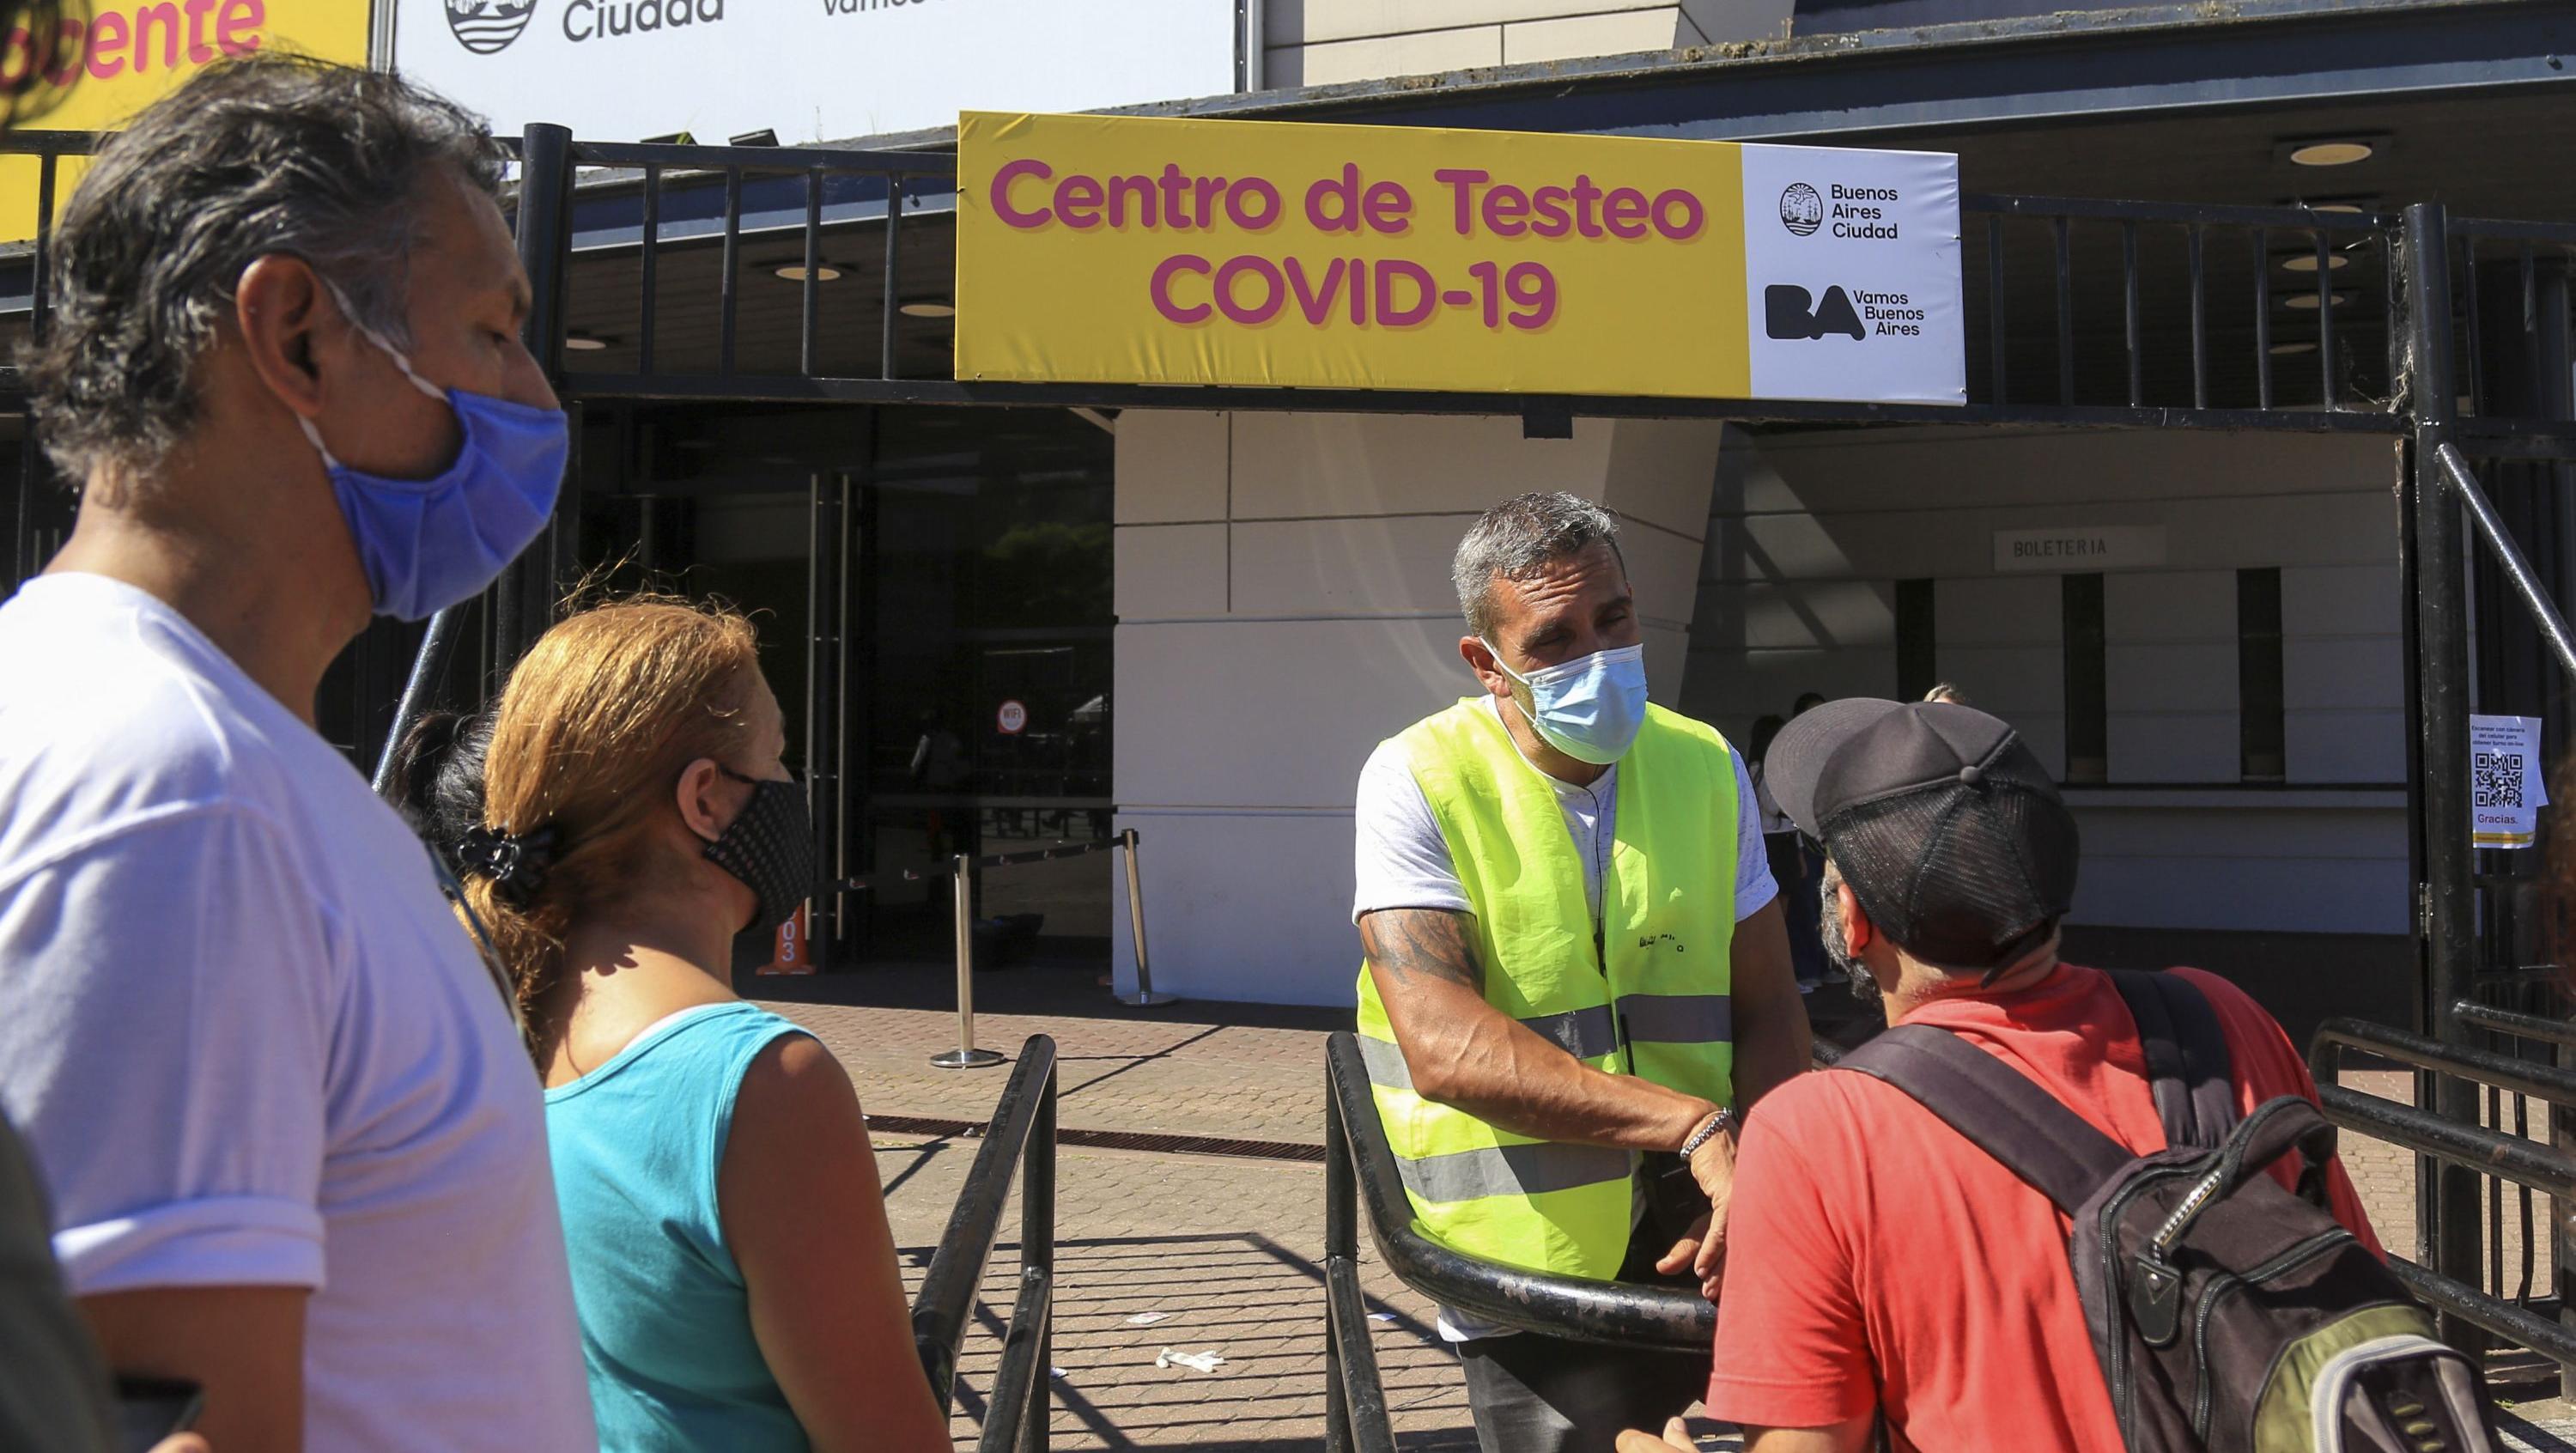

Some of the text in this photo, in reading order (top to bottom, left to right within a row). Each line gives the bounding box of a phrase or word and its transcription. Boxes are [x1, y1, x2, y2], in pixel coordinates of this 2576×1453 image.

[990, 159, 1705, 239] Centro de Testeo
[1831, 184, 1899, 201] Buenos
[1832, 204, 1882, 220] Aires
[1832, 222, 1899, 240] Ciudad
[1150, 254, 1557, 329] COVID-19
[1854, 289, 1909, 305] Vamos
[1765, 284, 1867, 341] BA
[1864, 306, 1924, 321] Buenos
[1875, 321, 1920, 337] Aires
[2014, 538, 2107, 557] BOLETERIA
[2477, 813, 2518, 824] Gracias.
